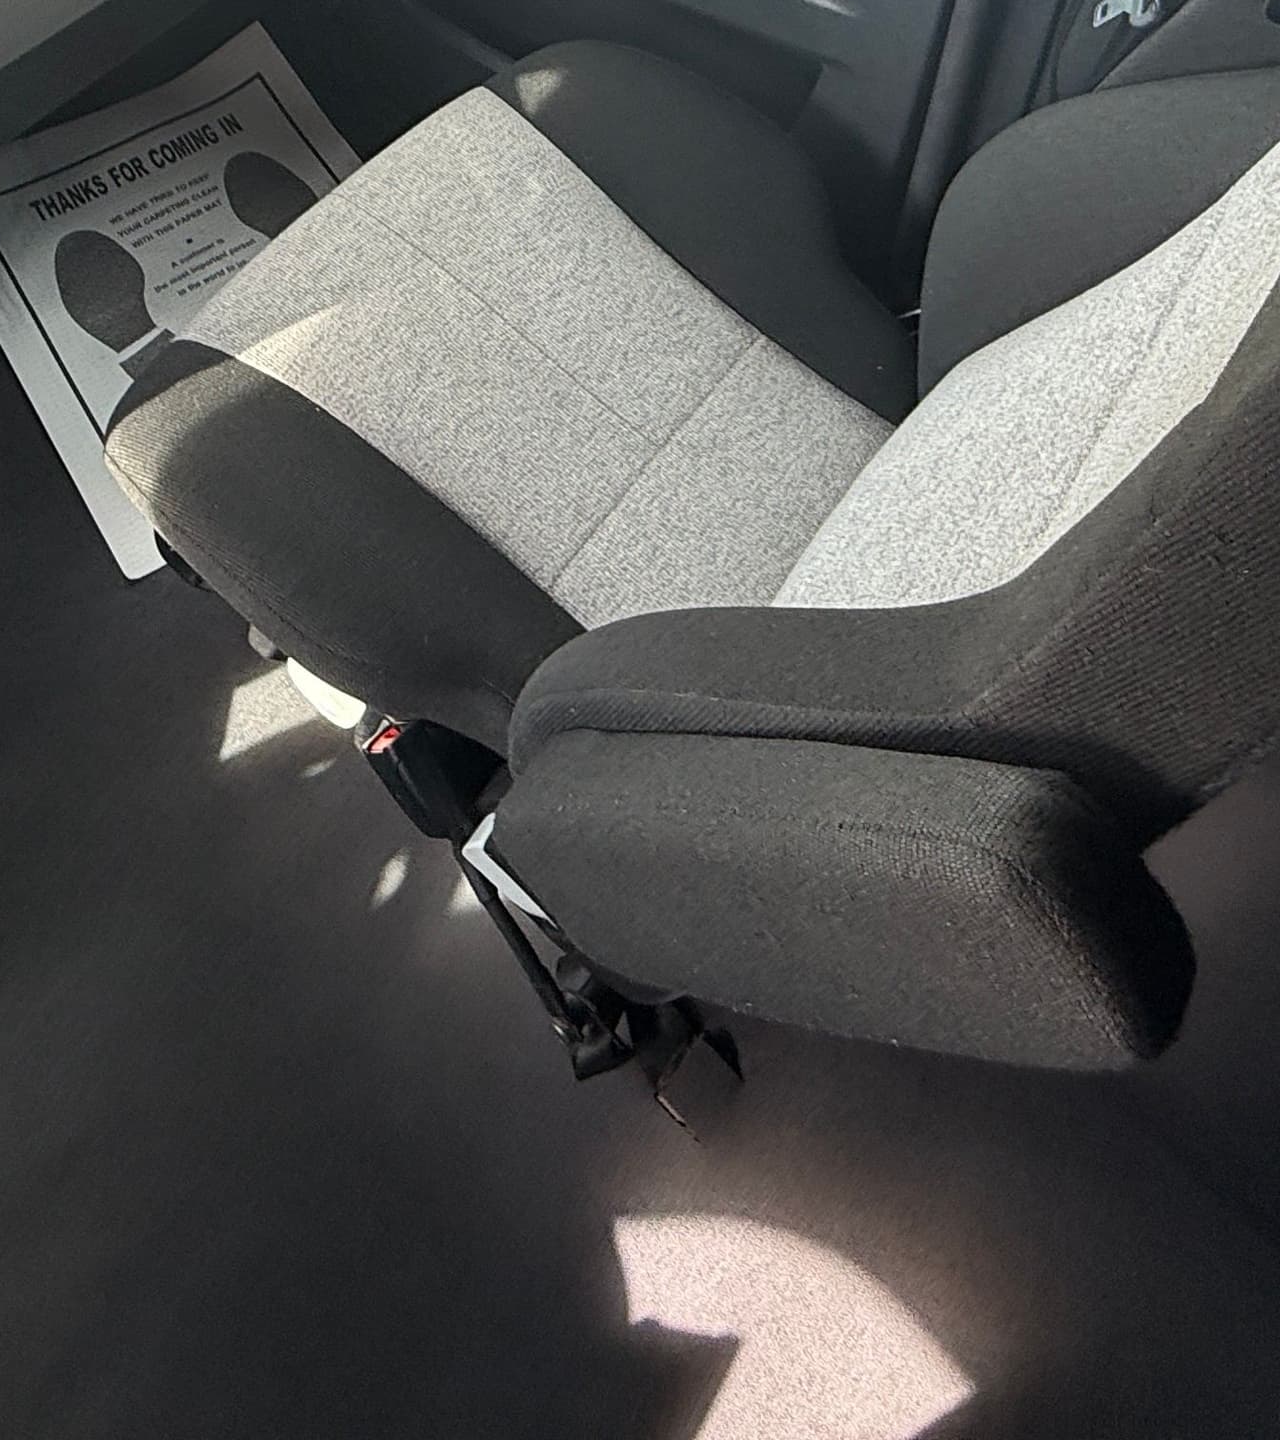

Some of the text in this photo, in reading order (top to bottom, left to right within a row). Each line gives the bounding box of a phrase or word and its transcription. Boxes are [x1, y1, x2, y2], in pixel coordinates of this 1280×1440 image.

[29, 113, 244, 221] THANKS FOR COMING IN
[109, 214, 123, 225] WE
[125, 203, 149, 218] HAVE
[175, 183, 188, 193] TO
[117, 185, 219, 238] YOUR CARPETING CLEAN
[131, 199, 223, 249] WITH THIS PAPER MAT
[153, 282, 170, 294] the
[170, 270, 191, 286] most
[190, 250, 228, 275] important
[188, 281, 202, 292] the
[202, 268, 226, 285] world
